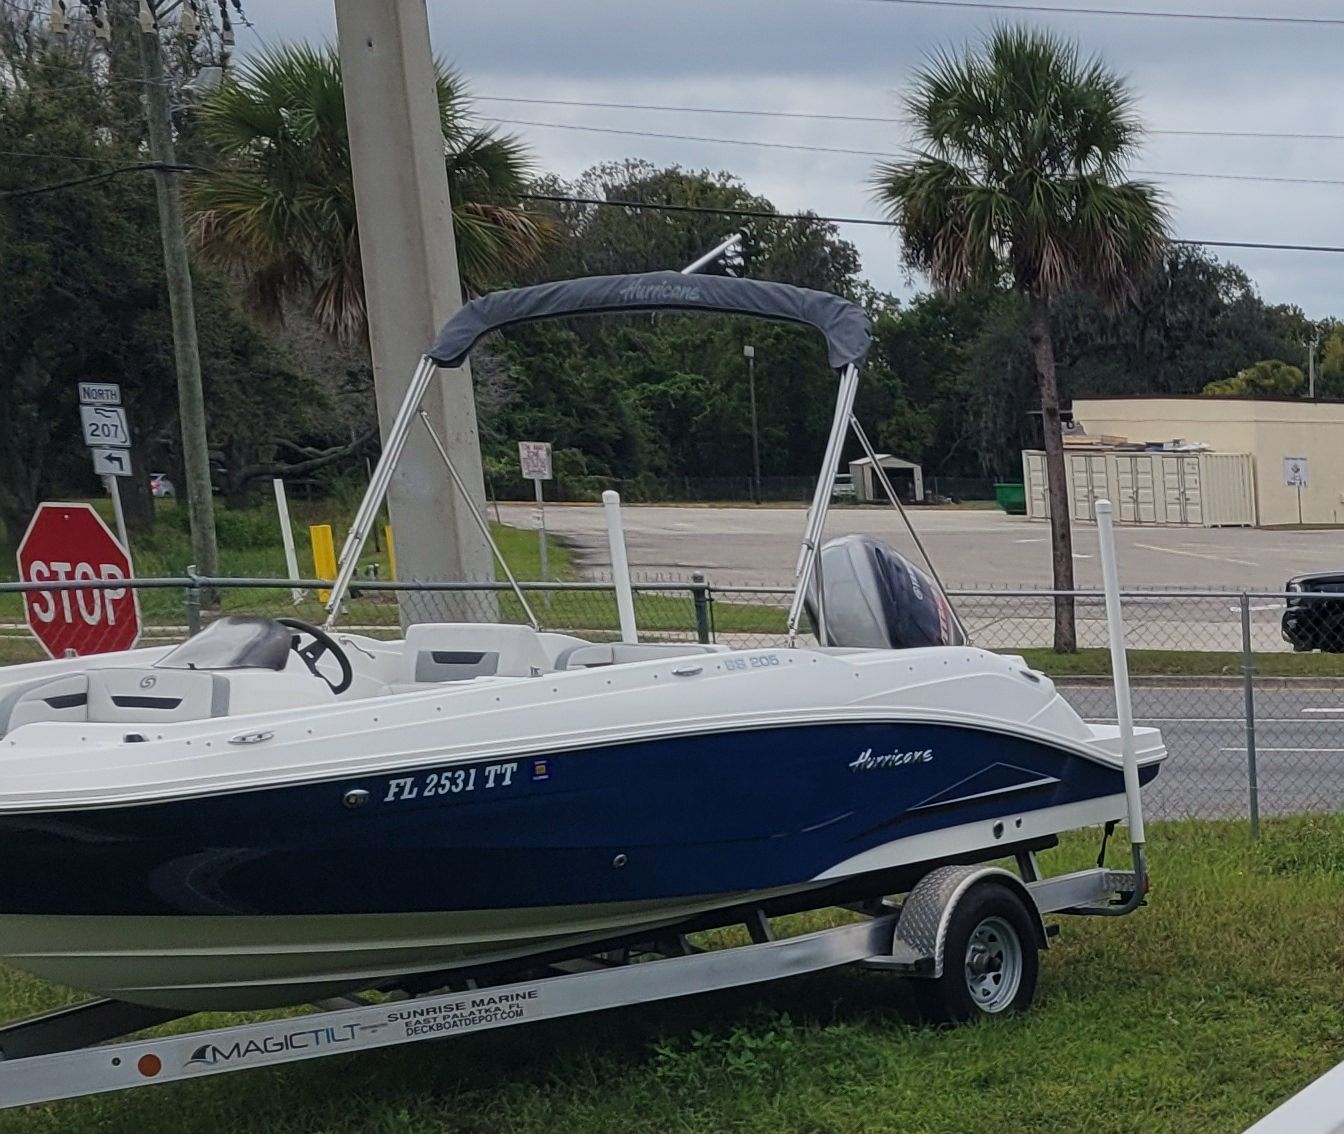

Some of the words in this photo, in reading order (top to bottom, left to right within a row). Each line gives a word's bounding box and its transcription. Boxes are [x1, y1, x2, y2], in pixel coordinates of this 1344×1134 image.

[620, 278, 701, 302] Hurricane
[82, 386, 118, 401] NORTH
[89, 422, 119, 438] 207
[29, 560, 127, 626] STOP
[749, 654, 779, 668] 205
[849, 748, 934, 771] Hurricane
[383, 777, 418, 802] FL
[422, 768, 477, 797] 2531
[484, 762, 518, 789] TT
[387, 1001, 466, 1023] SUNRISE
[471, 989, 538, 1009] MARINE
[404, 1016, 439, 1028] EAST
[508, 1002, 524, 1010] FL
[405, 1009, 525, 1037] DECKBOATDEPOT.COM
[211, 1023, 361, 1063] MAGICTILT
